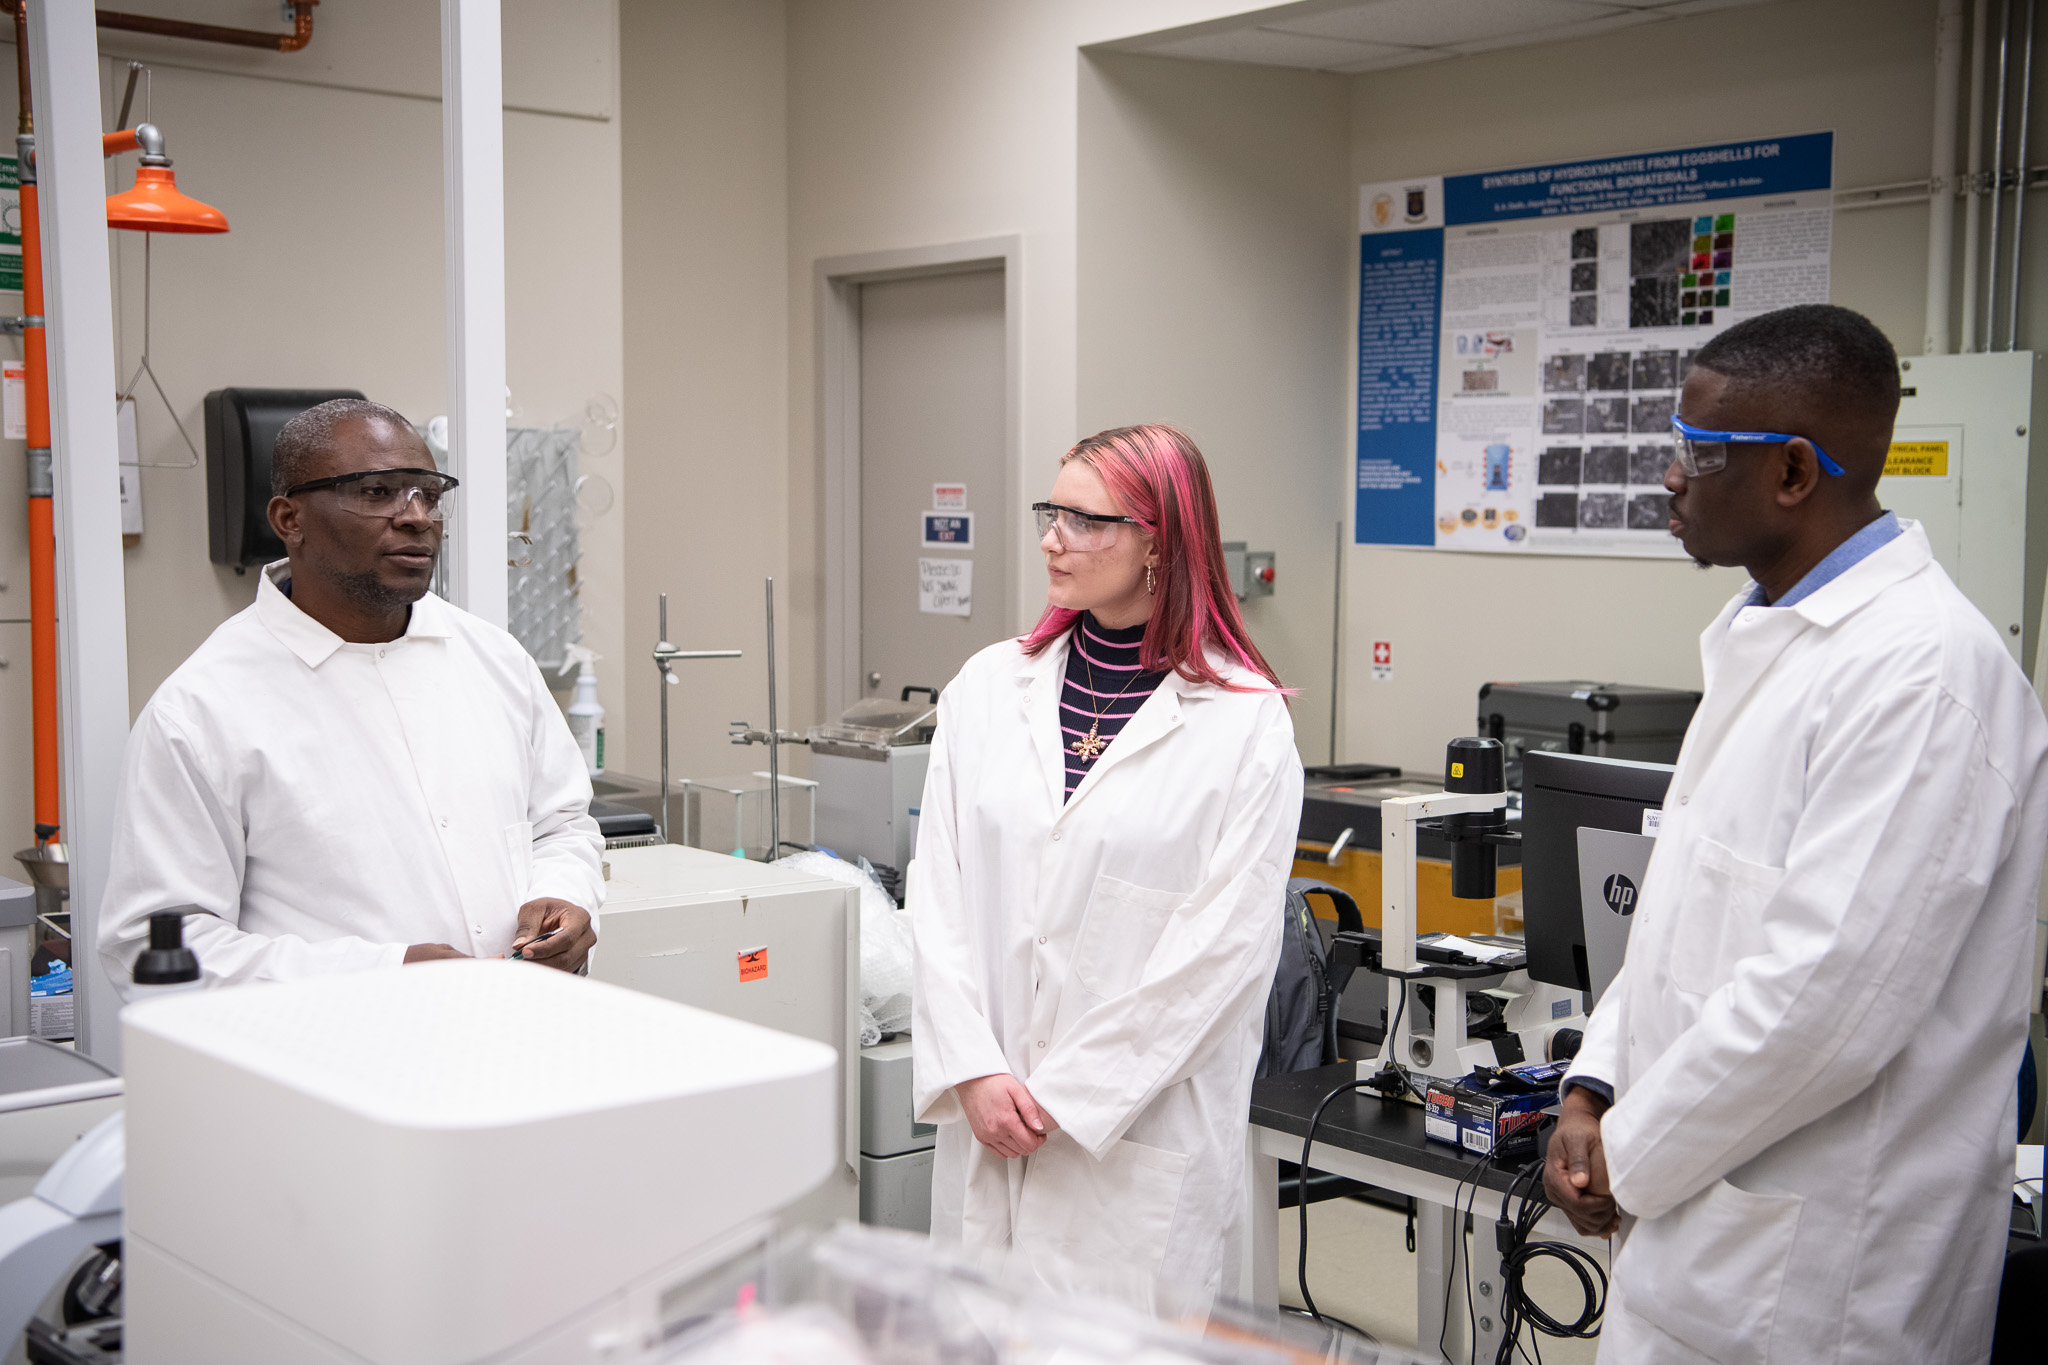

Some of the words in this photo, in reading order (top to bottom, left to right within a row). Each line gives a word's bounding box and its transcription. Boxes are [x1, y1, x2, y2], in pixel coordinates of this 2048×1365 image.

[1538, 169, 1552, 183] OF
[1647, 154, 1680, 170] FROM
[1754, 143, 1780, 159] FOR
[1885, 456, 1933, 465] LEARANCE
[1608, 874, 1634, 916] hp
[1427, 1091, 1455, 1108] TURBO
